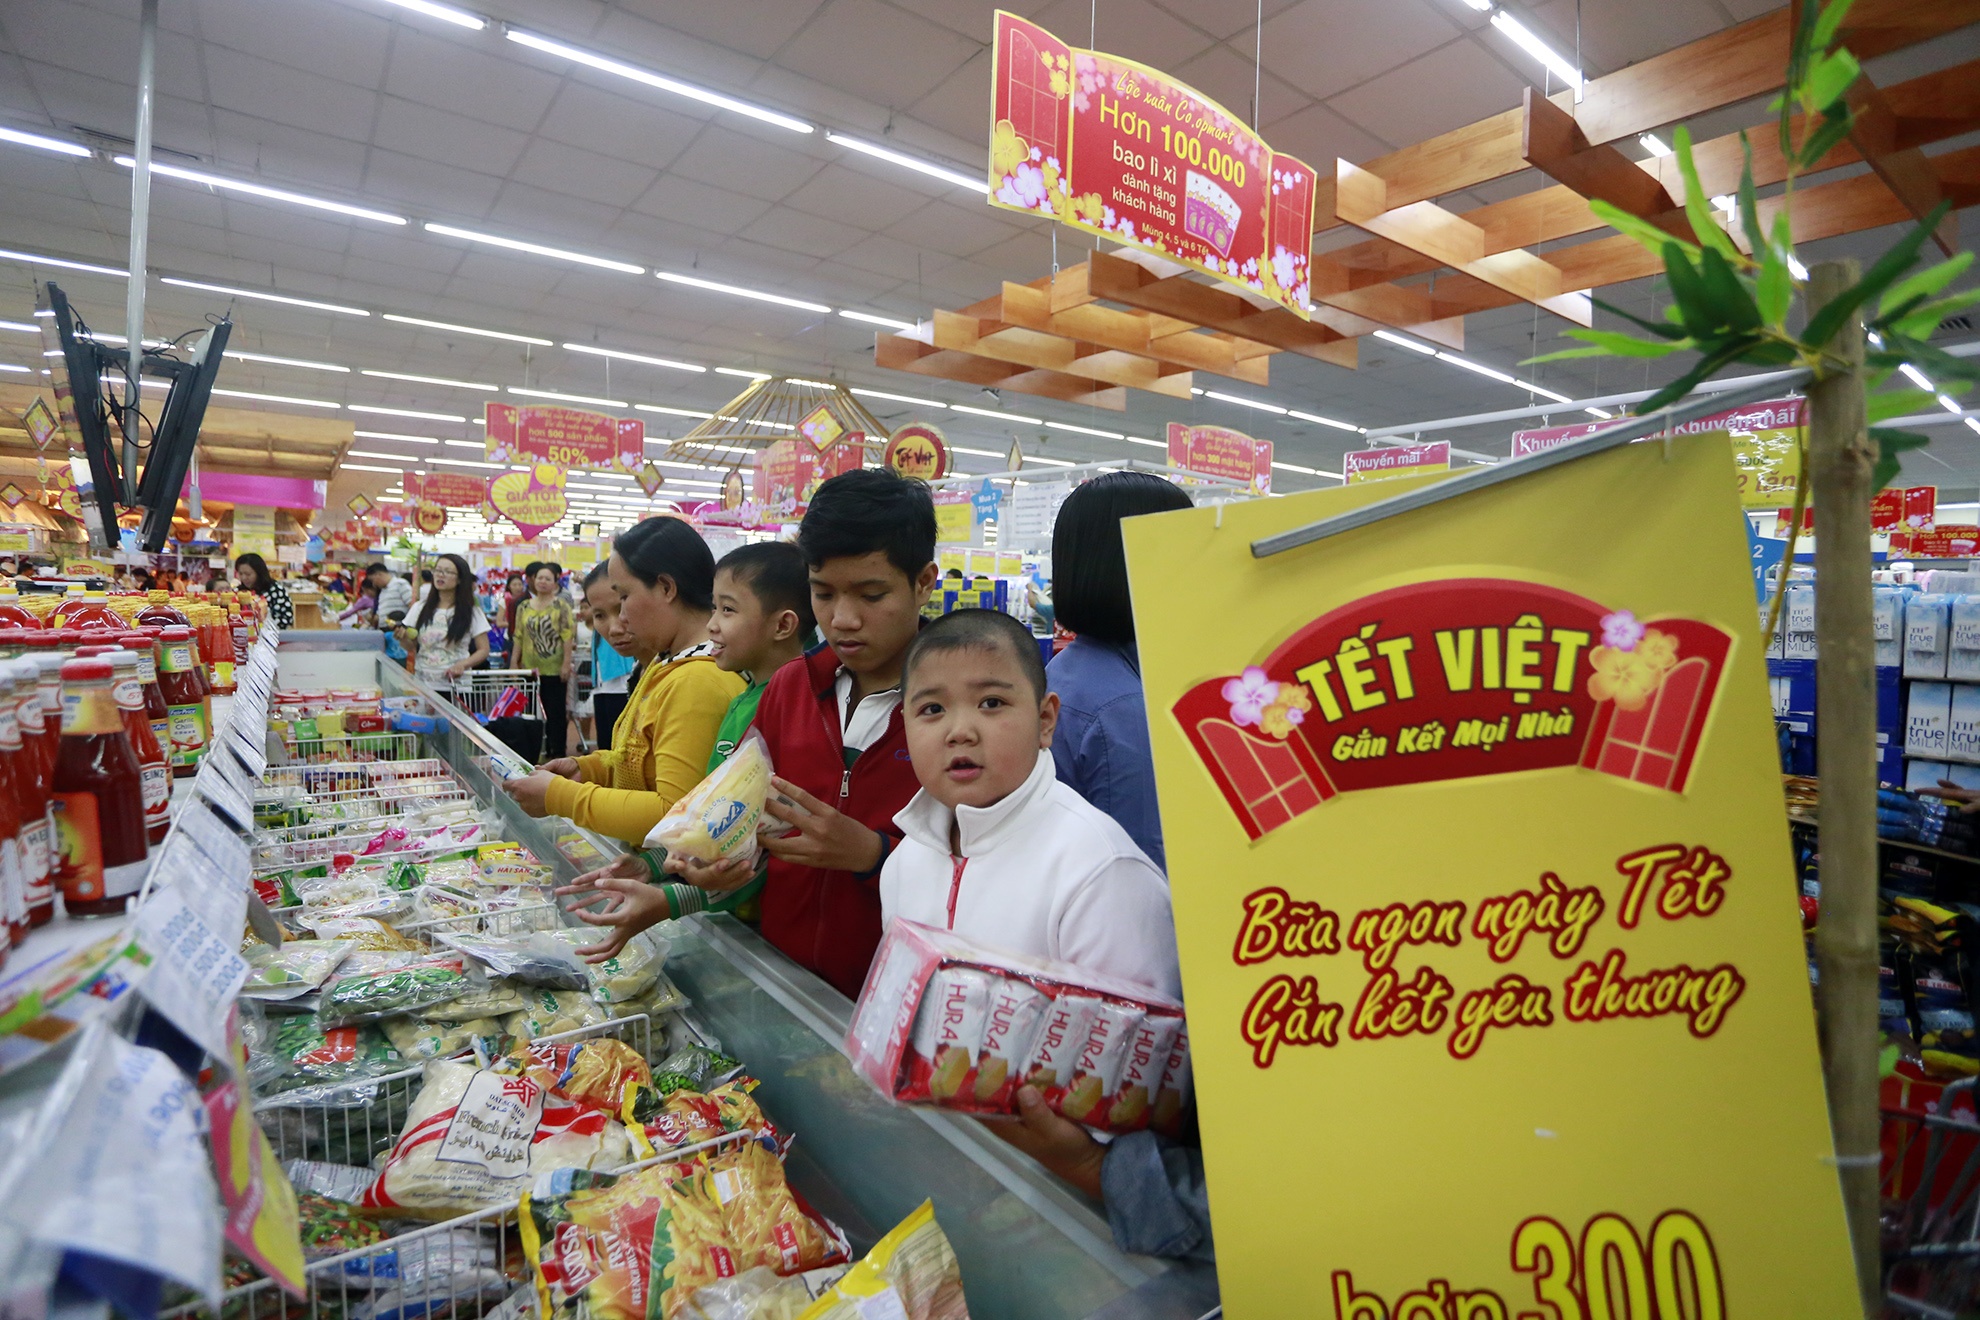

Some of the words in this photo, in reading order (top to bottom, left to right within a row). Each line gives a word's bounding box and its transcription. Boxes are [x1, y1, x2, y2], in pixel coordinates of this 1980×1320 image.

[1116, 71, 1140, 100] Lộc
[1143, 92, 1172, 115] xuân
[1175, 100, 1234, 144] Co.opmart
[1100, 93, 1151, 143] Hơn
[1161, 124, 1246, 188] 100.000
[1113, 139, 1145, 171] bao
[1150, 156, 1158, 177] lì
[1163, 165, 1176, 185] xì
[1112, 187, 1146, 211] khách
[1149, 201, 1176, 226] hàng
[1122, 172, 1150, 193] dành
[1153, 185, 1176, 208] tặng
[548, 445, 589, 464] 50%
[1755, 470, 1797, 498] tặn
[1752, 543, 1764, 559] 2
[1909, 633, 1933, 642] true
[1296, 620, 1416, 723] TẾT
[1434, 614, 1590, 705] VIỆT
[1331, 724, 1388, 762] Gắn
[1396, 721, 1446, 754] Kết
[1452, 715, 1508, 752] Mọi
[1515, 706, 1573, 740] Nhà
[1909, 725, 1945, 739] true
[1909, 737, 1944, 749] MILK
[1910, 716, 1930, 726] TH
[720, 826, 748, 852] KHOAI
[1234, 886, 1340, 966] Bữa
[1349, 901, 1465, 974] ngon
[1473, 872, 1603, 962] ngày
[1617, 844, 1731, 929] Tết
[891, 978, 919, 1047] HURA
[940, 983, 968, 1040] HURA
[984, 994, 1019, 1051] HURA
[1242, 974, 1344, 1068] Gắn
[1349, 966, 1453, 1039] kết
[1448, 974, 1552, 1059] yêu
[1564, 949, 1745, 1039] thương
[1037, 1010, 1071, 1062] HURA
[1079, 1017, 1111, 1070] HURA
[1126, 1028, 1156, 1081] HURA
[455, 1110, 501, 1135] French
[561, 1224, 590, 1288] LUTOSA
[1510, 1209, 1726, 1320] 300
[631, 1271, 641, 1304] FRENCH
